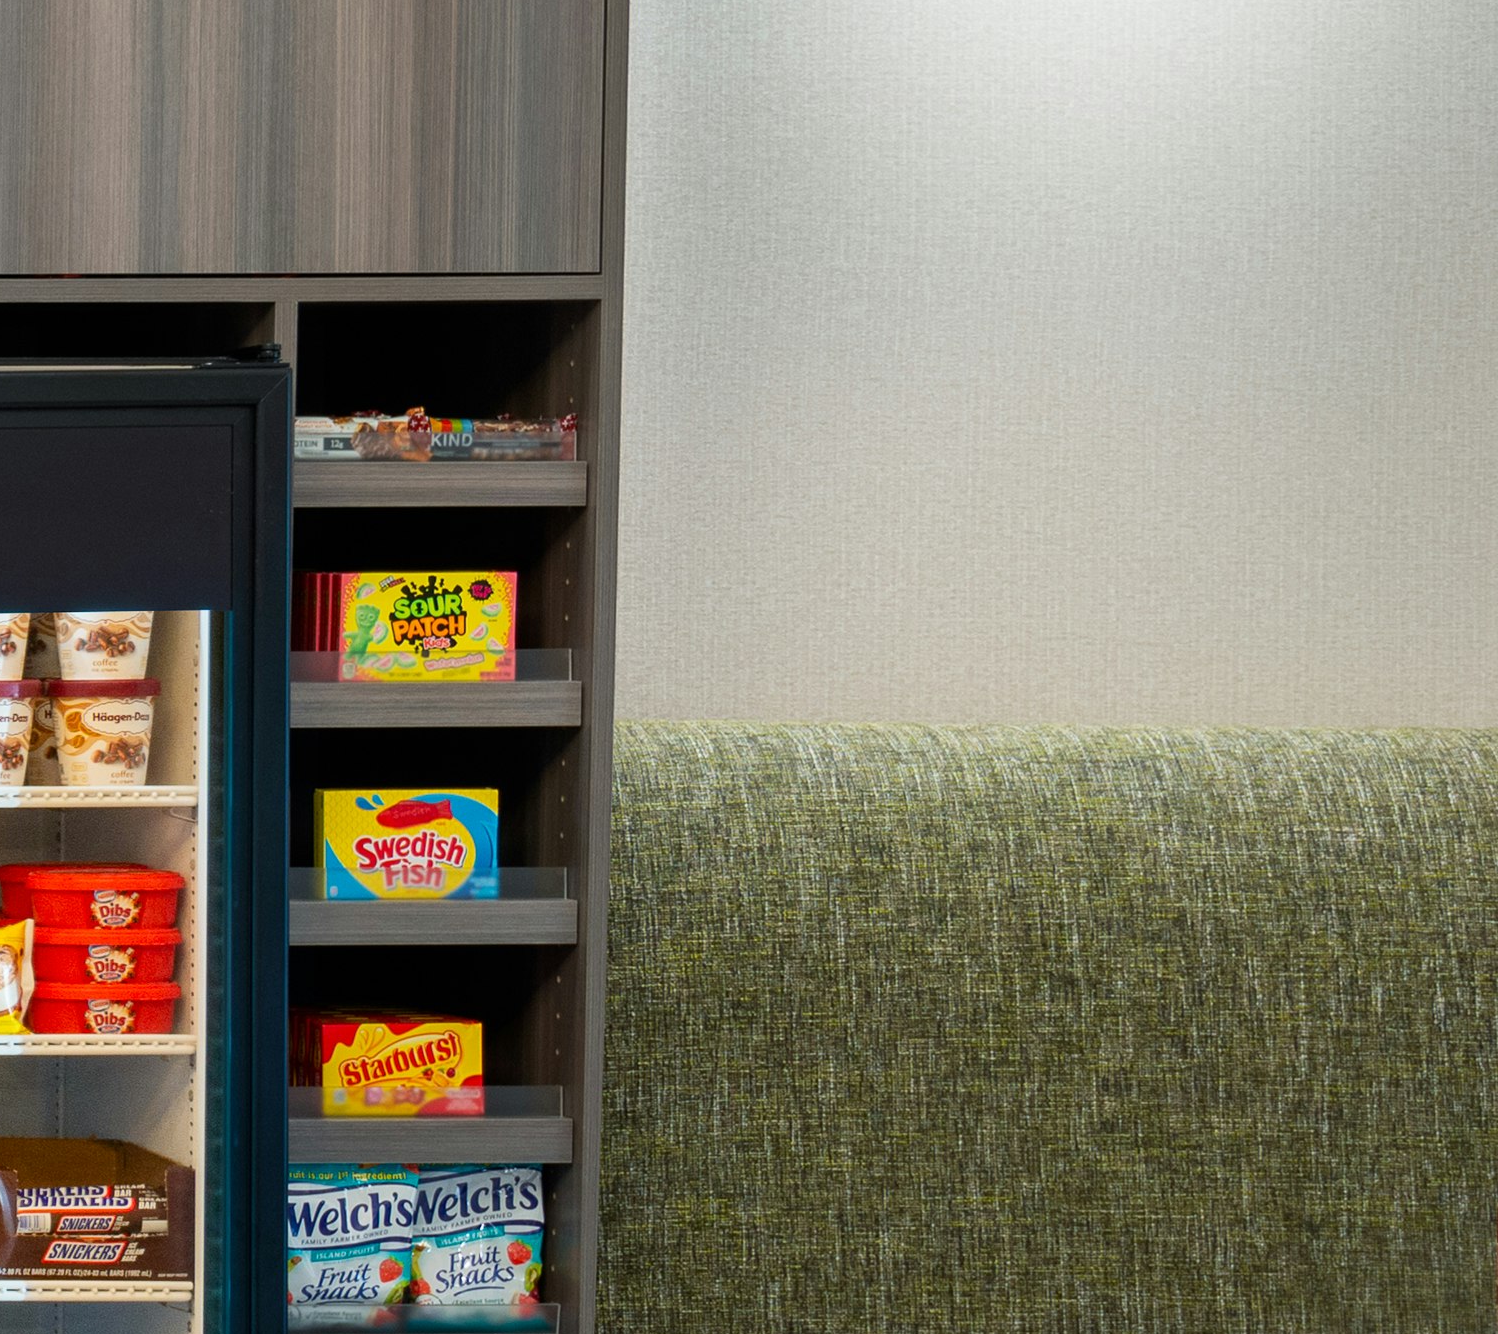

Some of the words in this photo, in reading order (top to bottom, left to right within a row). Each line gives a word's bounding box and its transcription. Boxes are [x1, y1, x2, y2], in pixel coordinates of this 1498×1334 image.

[430, 434, 473, 447] KIND
[394, 594, 462, 618] SOUR
[392, 615, 466, 641] PATCH
[355, 832, 465, 870] Swedish
[379, 859, 445, 888] Fish
[99, 903, 133, 920] Dibs
[342, 1032, 459, 1086] Starburst
[413, 1176, 539, 1224] Welch's
[58, 1216, 114, 1233] SNICKERS
[288, 1192, 413, 1238] Welch's
[45, 1241, 126, 1263] SNICKERS
[449, 1247, 502, 1273] Fruit
[318, 1264, 371, 1290] Fruit
[436, 1265, 514, 1293] Snacks
[297, 1282, 380, 1303] Snacks
